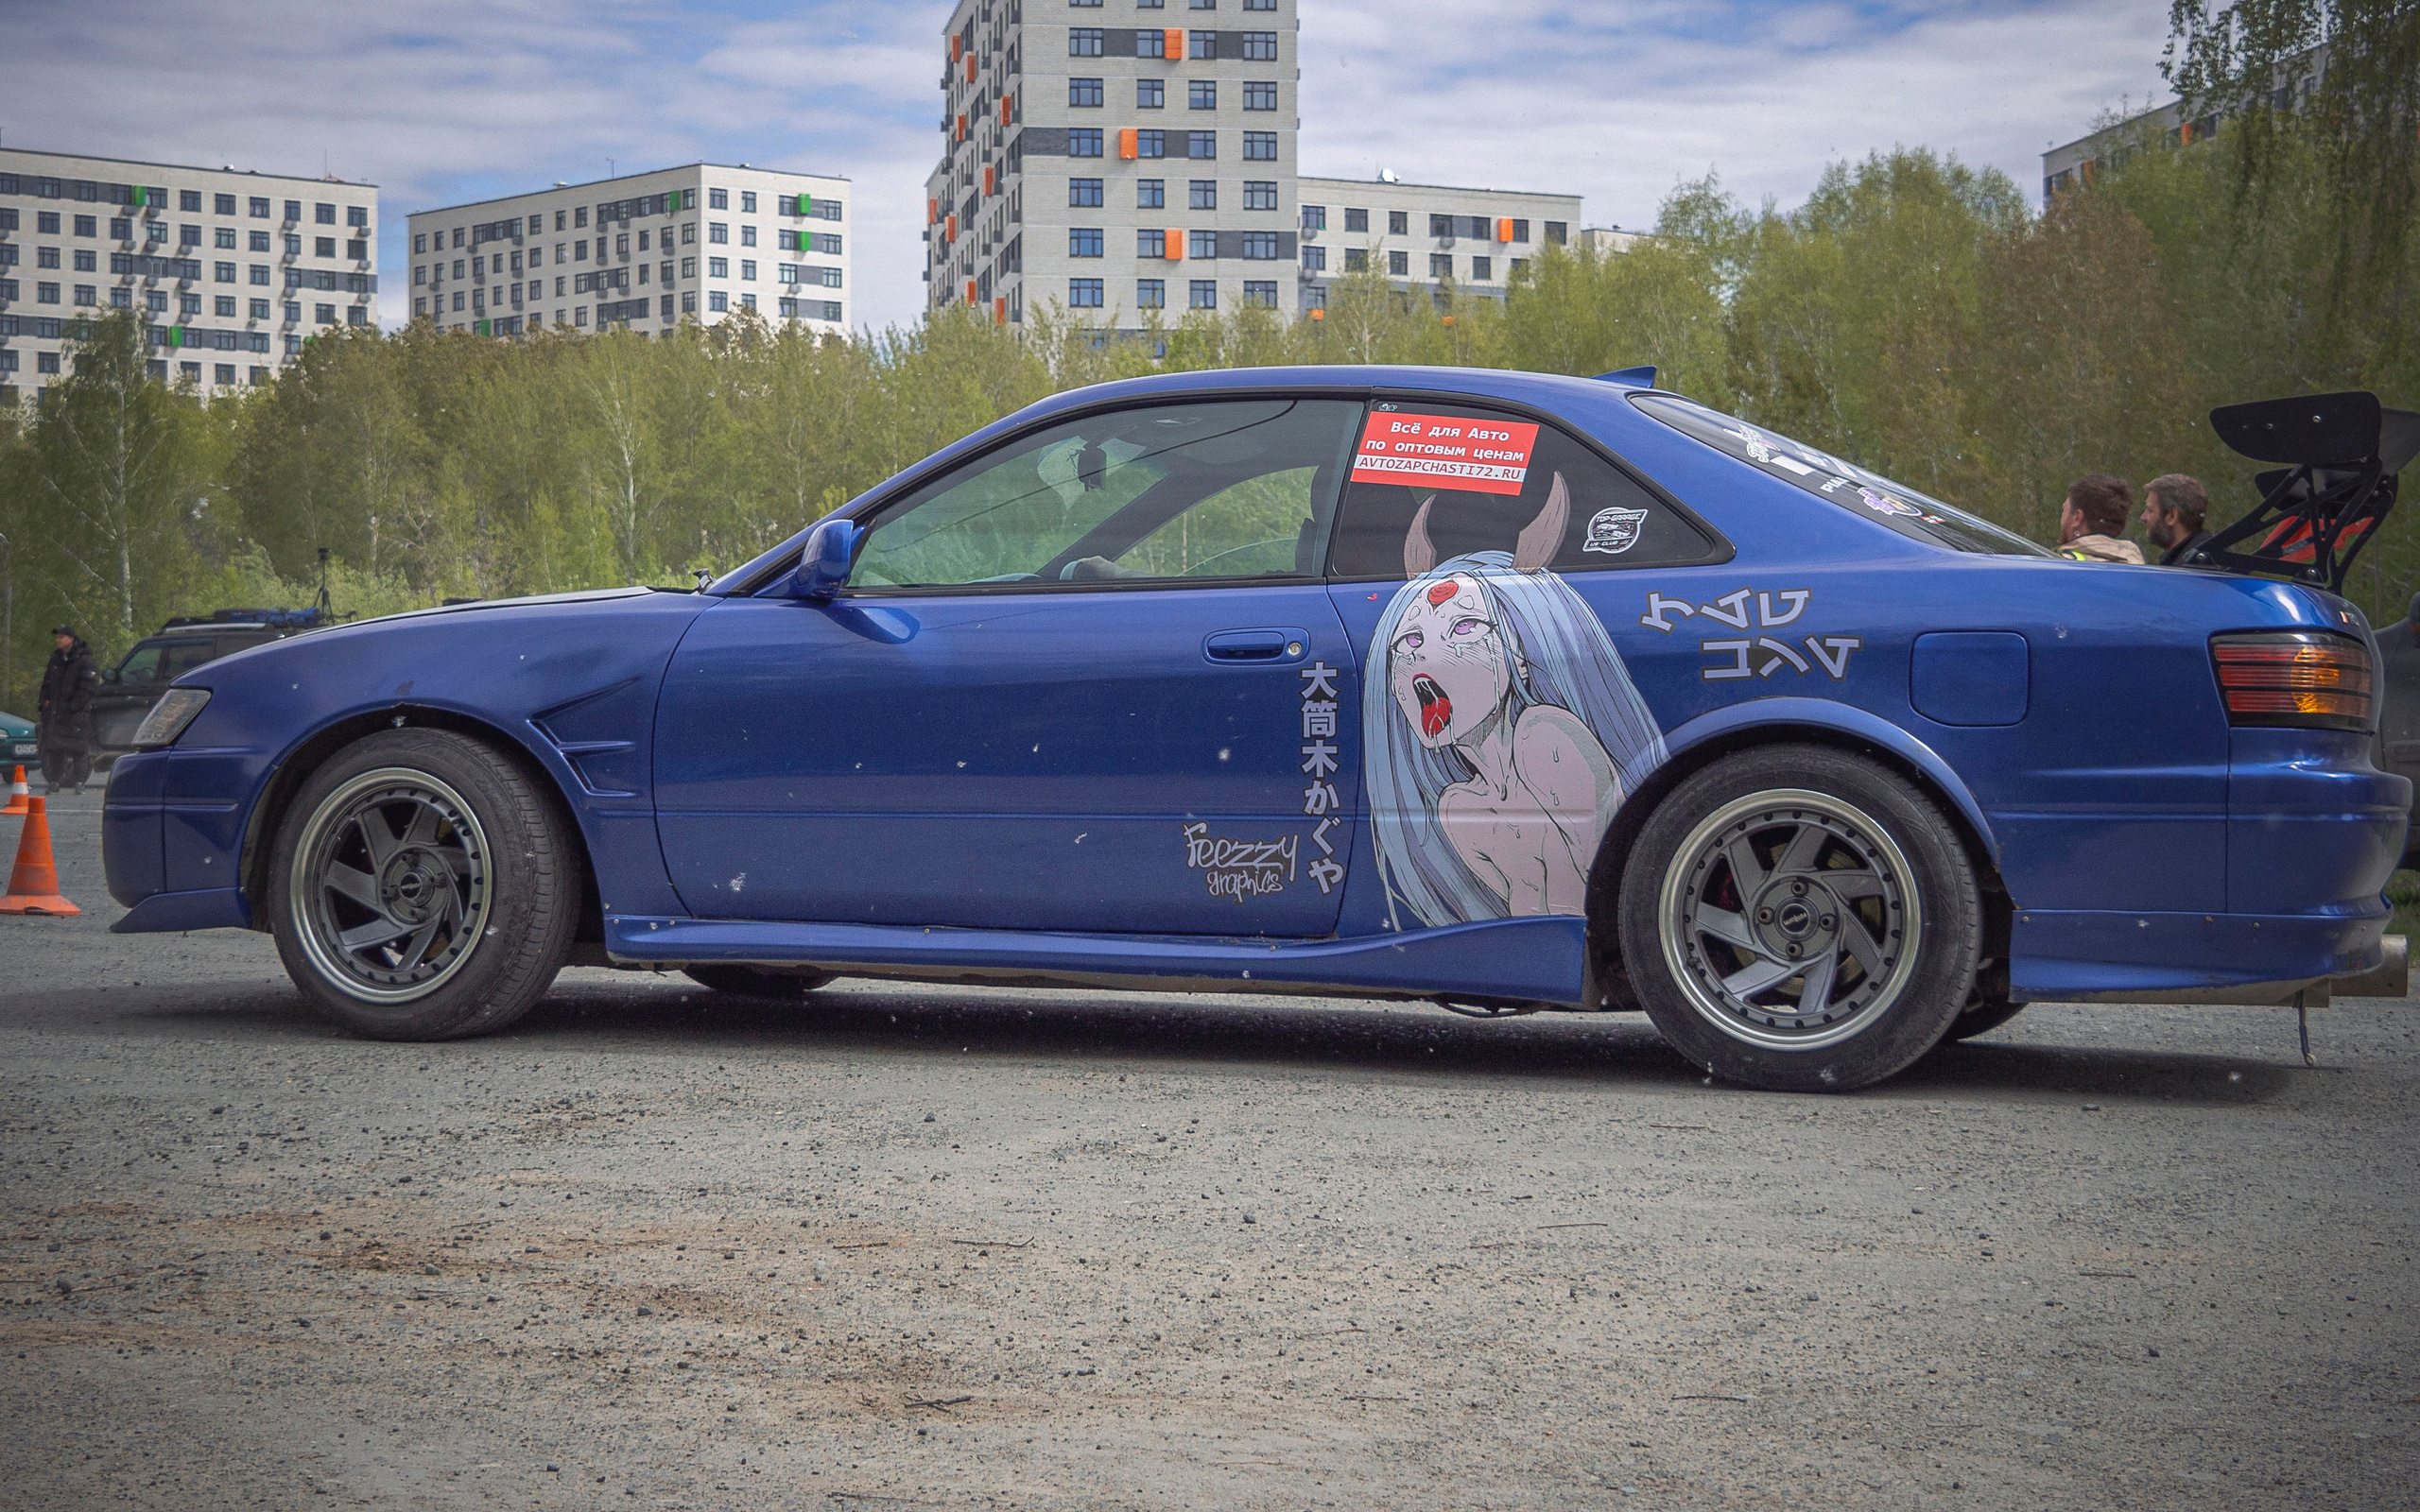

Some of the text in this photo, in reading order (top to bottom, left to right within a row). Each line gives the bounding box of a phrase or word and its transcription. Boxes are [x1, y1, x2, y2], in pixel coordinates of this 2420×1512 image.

[1391, 421, 1510, 441] Всё для Авто
[1365, 439, 1524, 462] по оптовым ценам
[1358, 456, 1521, 480] AVTOZAPCHASTI72.RU
[1300, 661, 1344, 894] 大筒木かぐや
[1206, 869, 1284, 903] graphics
